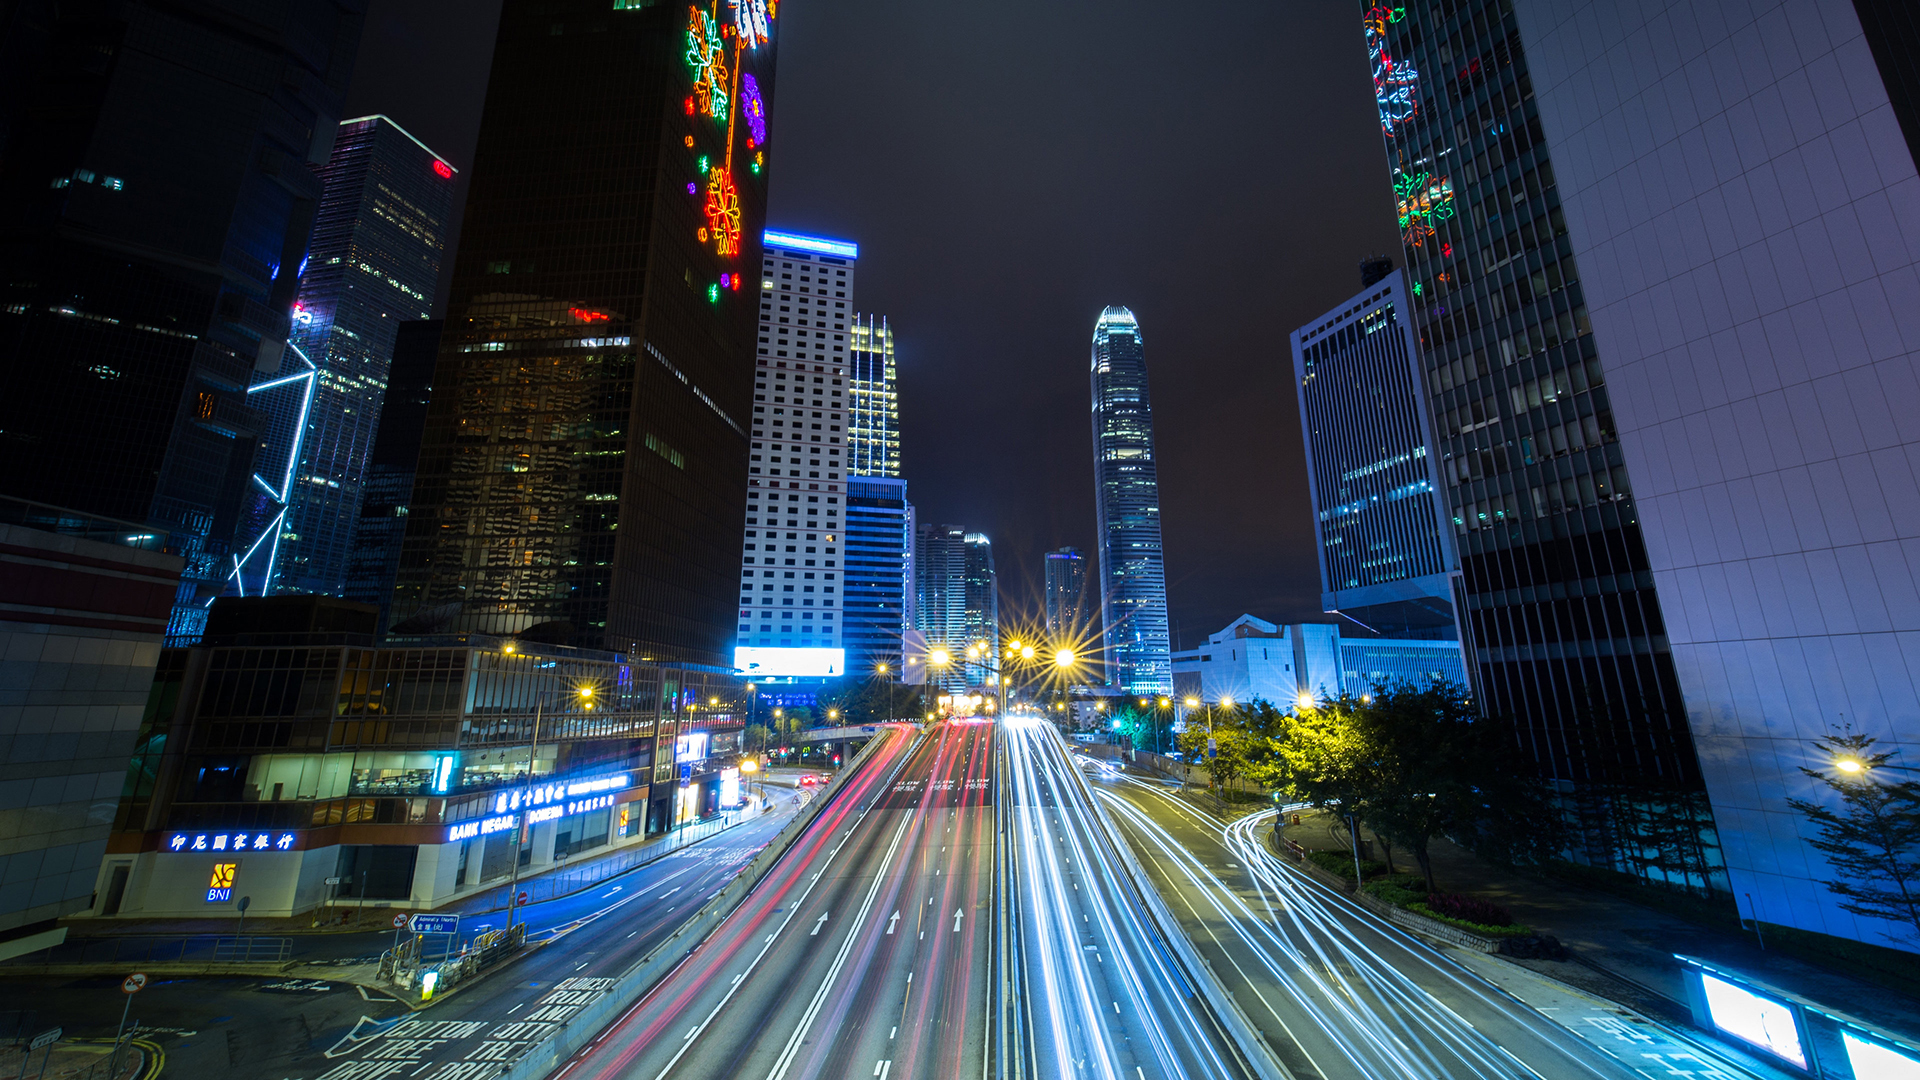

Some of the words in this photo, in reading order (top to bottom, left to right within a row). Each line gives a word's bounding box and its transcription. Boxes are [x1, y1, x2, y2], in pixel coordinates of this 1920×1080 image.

[449, 821, 479, 841] BANK
[481, 815, 514, 835] NEGAR
[171, 833, 293, 851] 印尼國家銀行
[207, 888, 231, 901] BNI
[384, 1020, 489, 1039] COTTON
[362, 1039, 448, 1059] TREE
[316, 1060, 419, 1080] DRIVE
